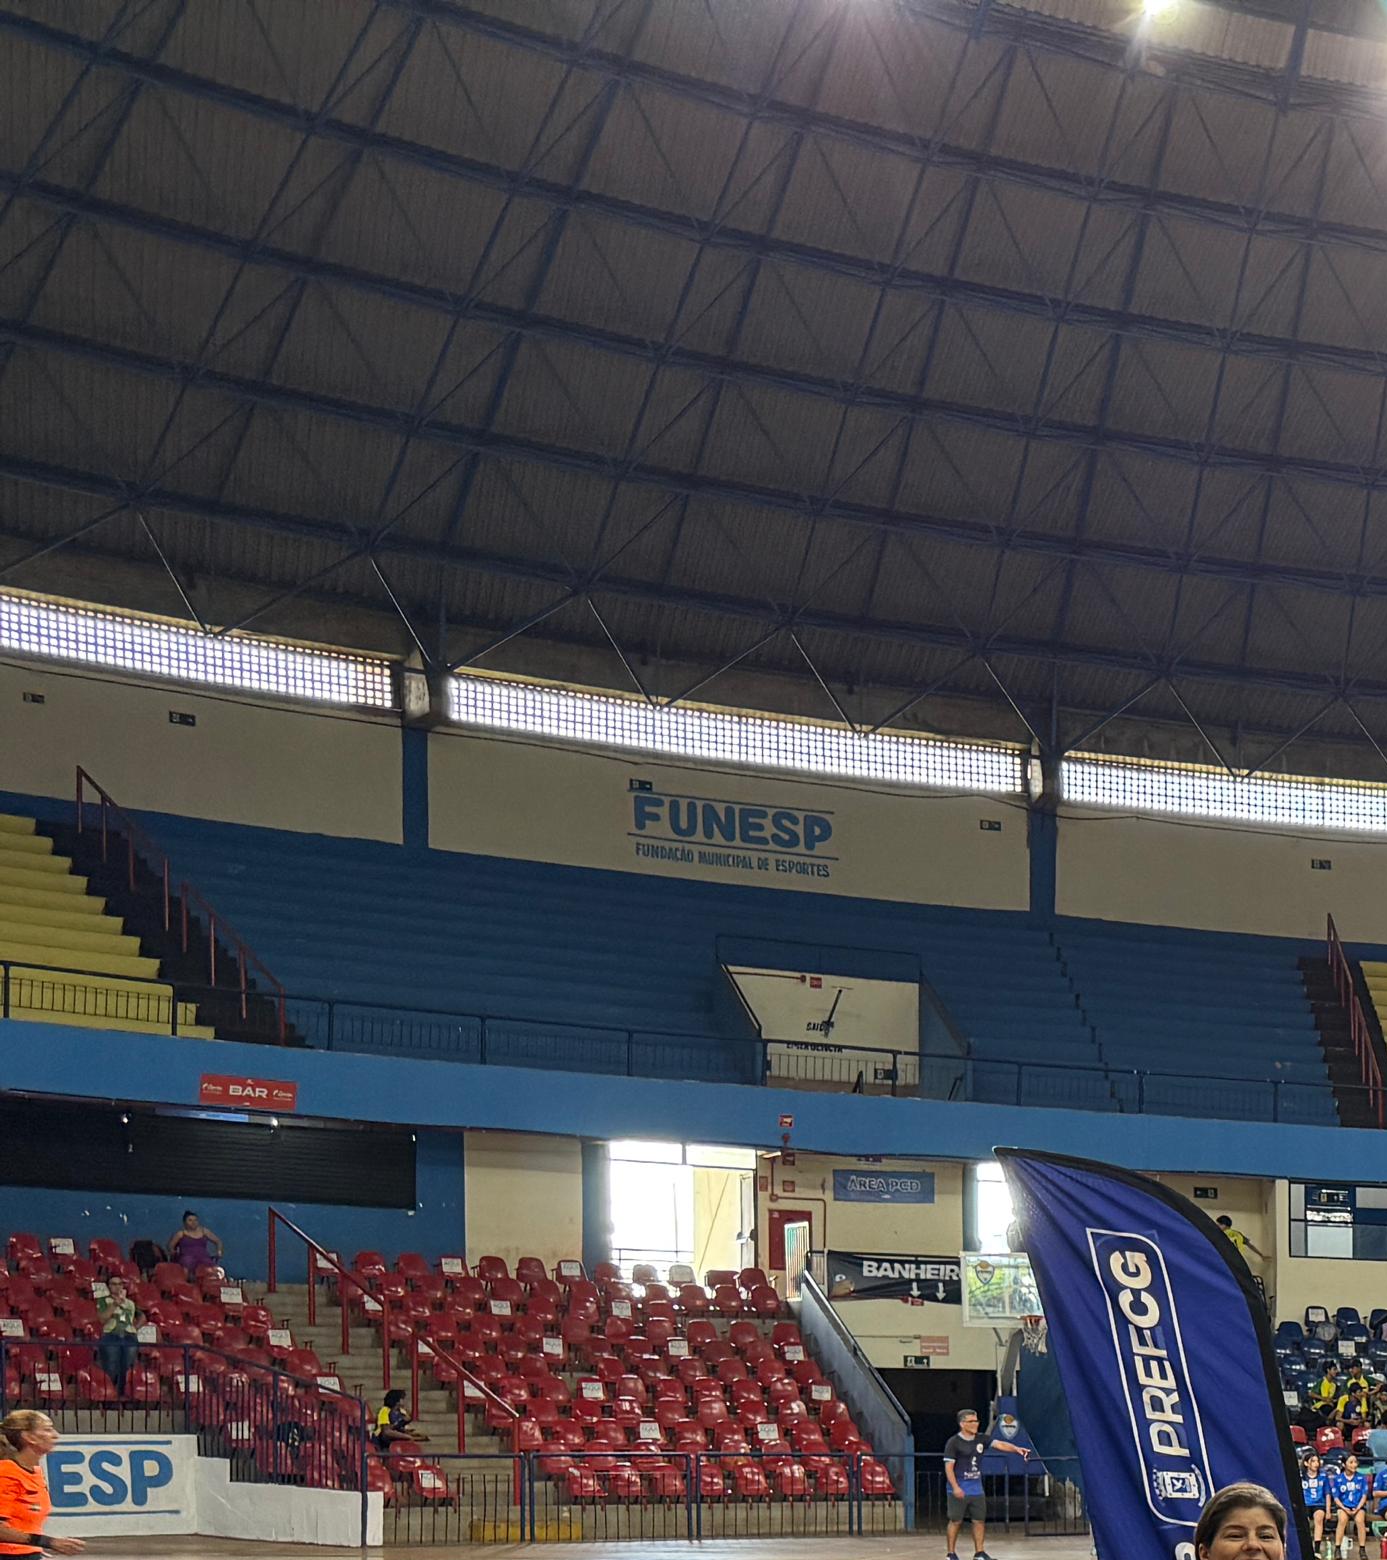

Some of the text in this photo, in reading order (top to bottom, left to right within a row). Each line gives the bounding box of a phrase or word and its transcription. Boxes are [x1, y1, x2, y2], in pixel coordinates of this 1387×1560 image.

[633, 795, 833, 851] FUNESP
[636, 842, 830, 878] FUNDAÇÃO MUNICIPAL DE ESPORTES
[229, 1084, 269, 1099] BAR
[888, 1179, 921, 1192] PCD
[862, 1260, 961, 1281] BANHEIR
[1109, 1250, 1190, 1457] PREFCG
[45, 1449, 174, 1508] ESP
